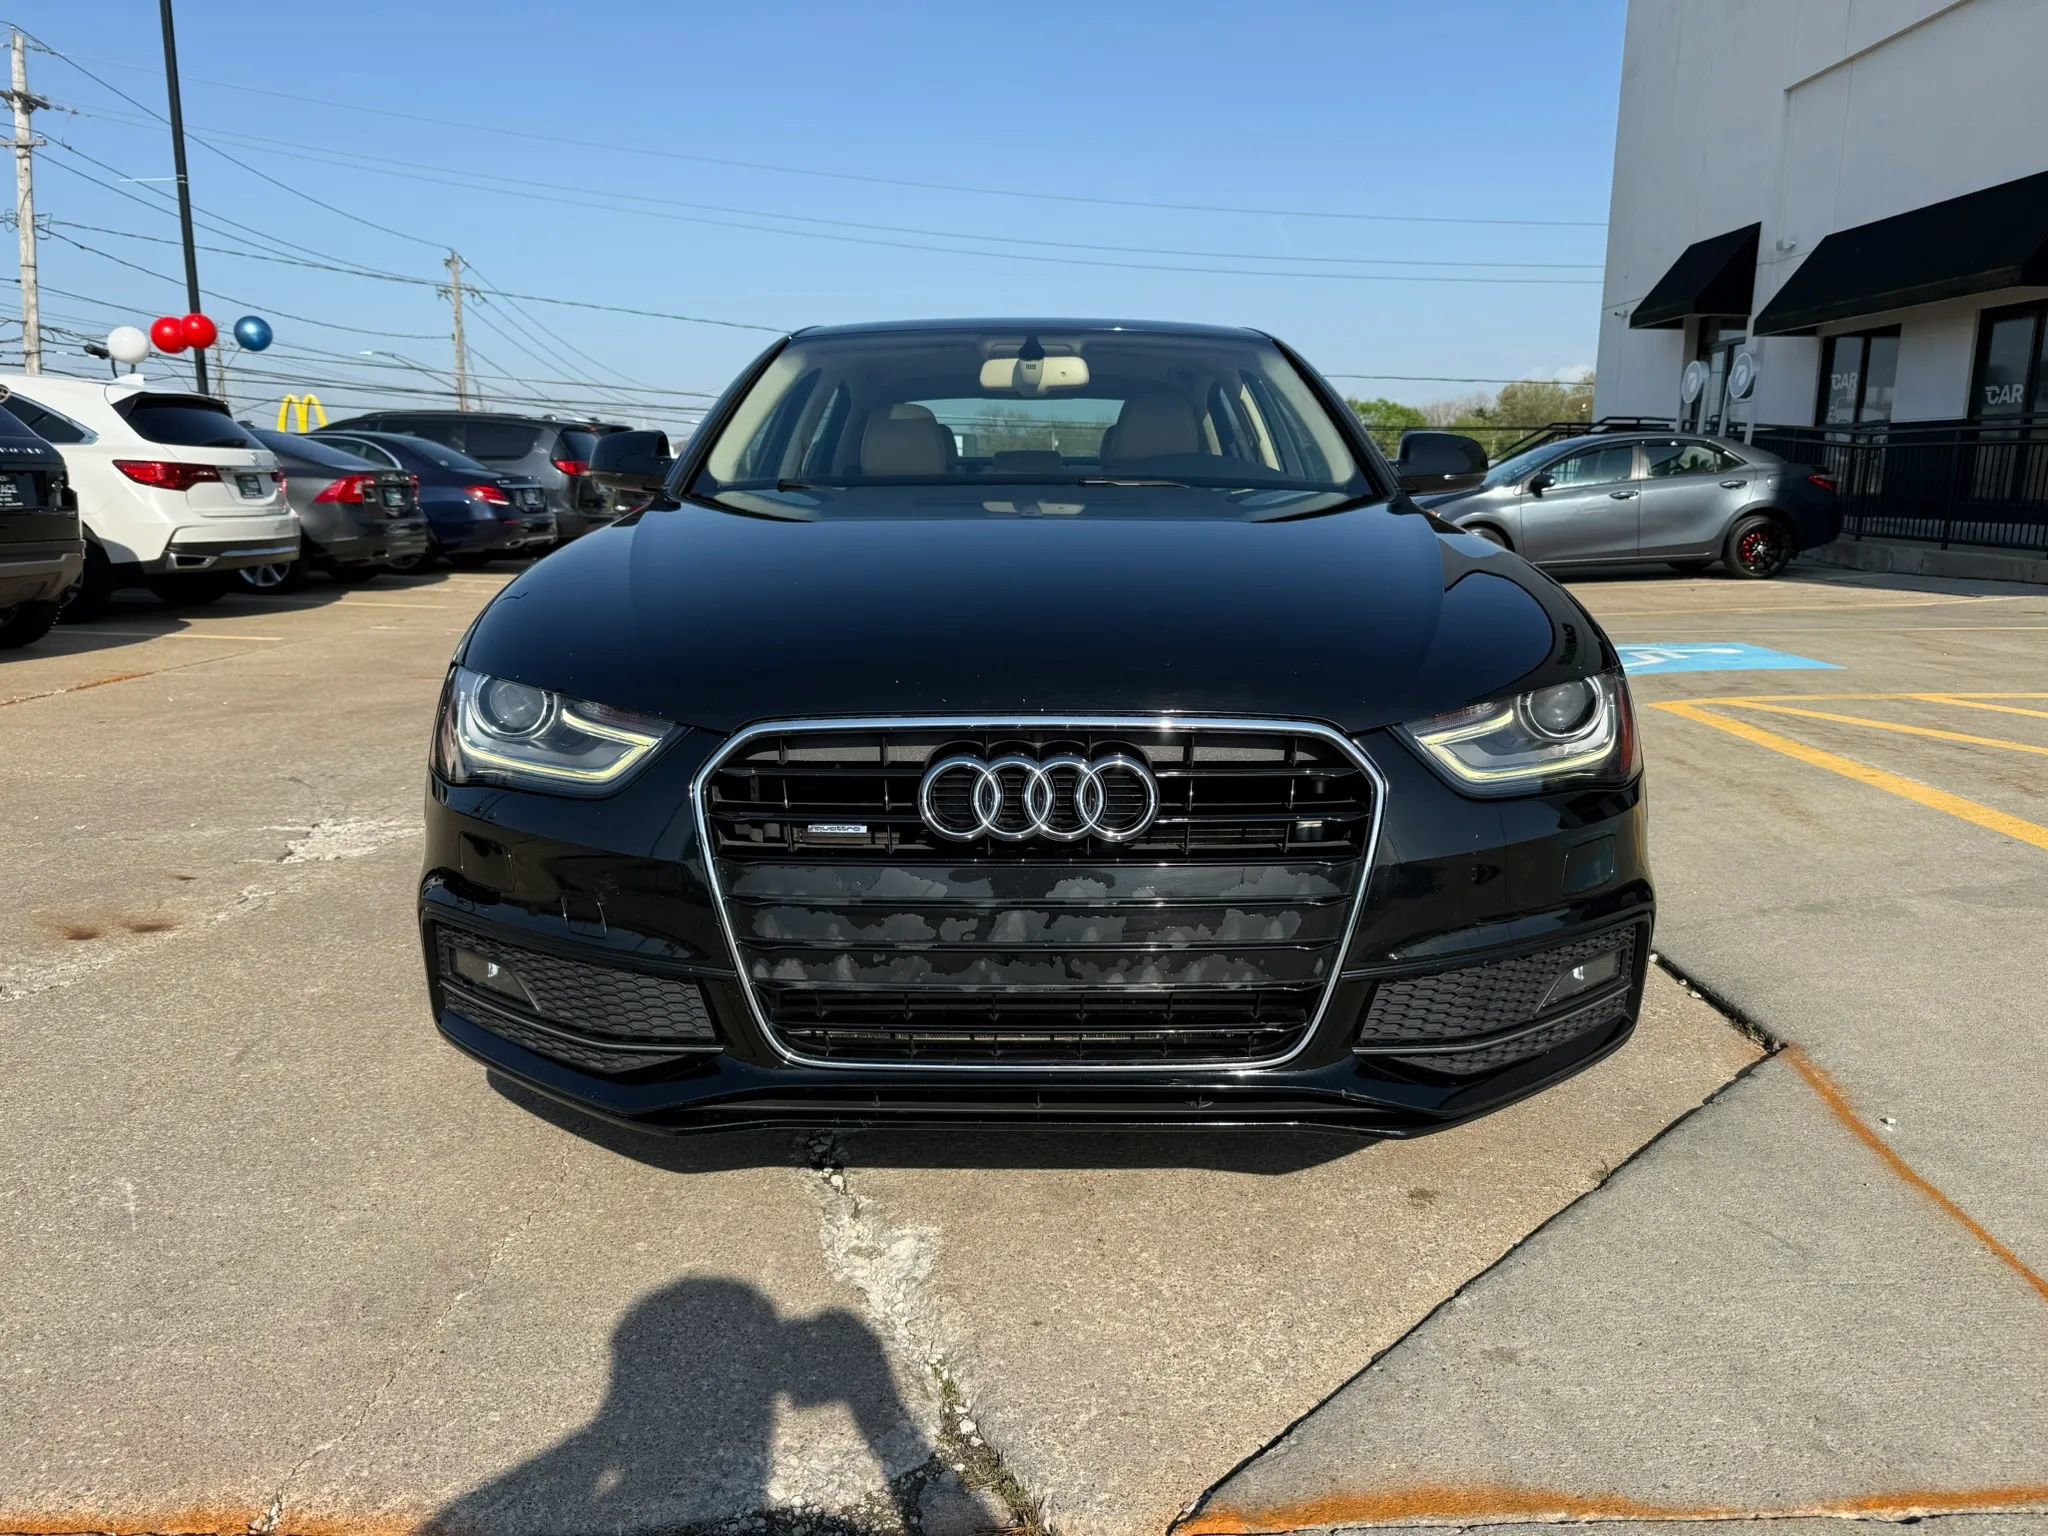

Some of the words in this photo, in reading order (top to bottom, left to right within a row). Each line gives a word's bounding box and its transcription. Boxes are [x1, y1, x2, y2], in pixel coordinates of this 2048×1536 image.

[1831, 372, 1858, 390] CAR
[1984, 383, 2024, 405] CAR
[812, 825, 863, 833] quattro
